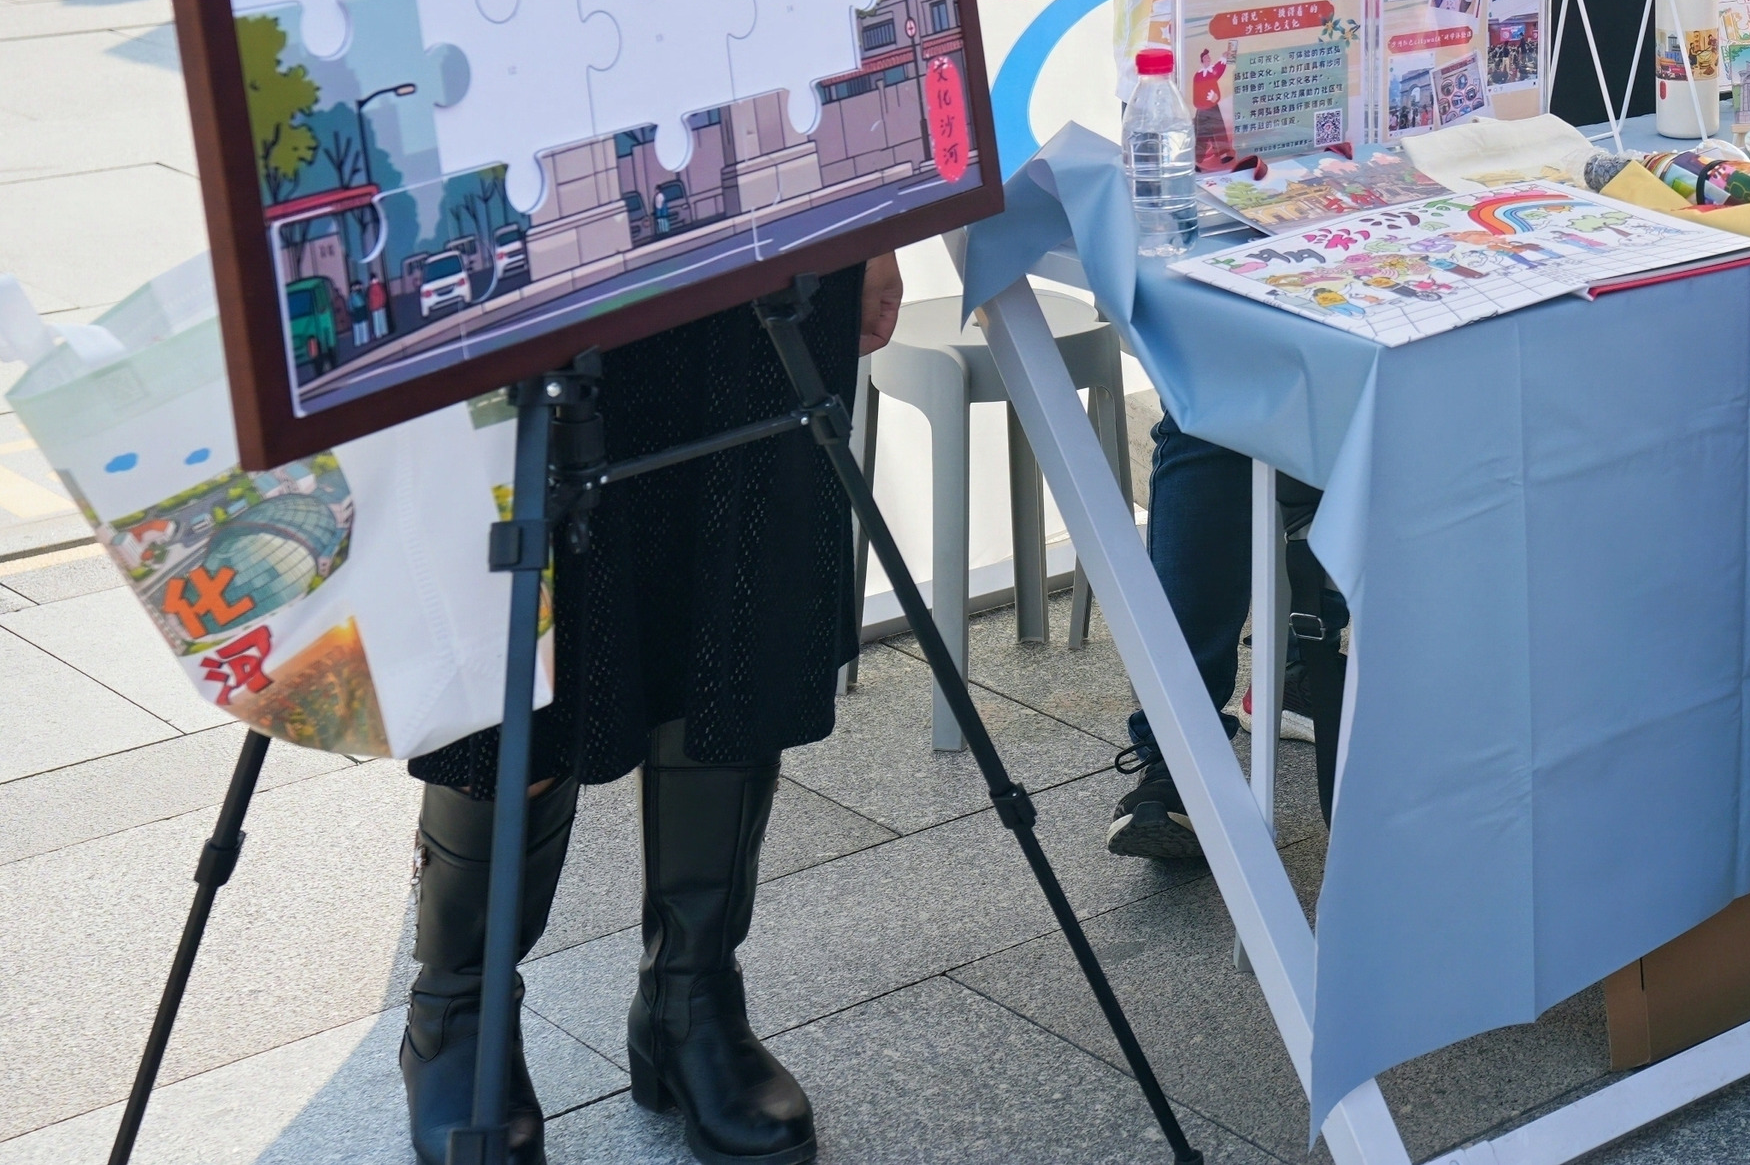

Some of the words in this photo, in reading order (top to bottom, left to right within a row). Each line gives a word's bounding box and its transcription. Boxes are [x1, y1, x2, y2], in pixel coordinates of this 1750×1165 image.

[932, 61, 960, 166] 文化沙河
[162, 565, 256, 640] 化
[199, 624, 275, 707] 河
